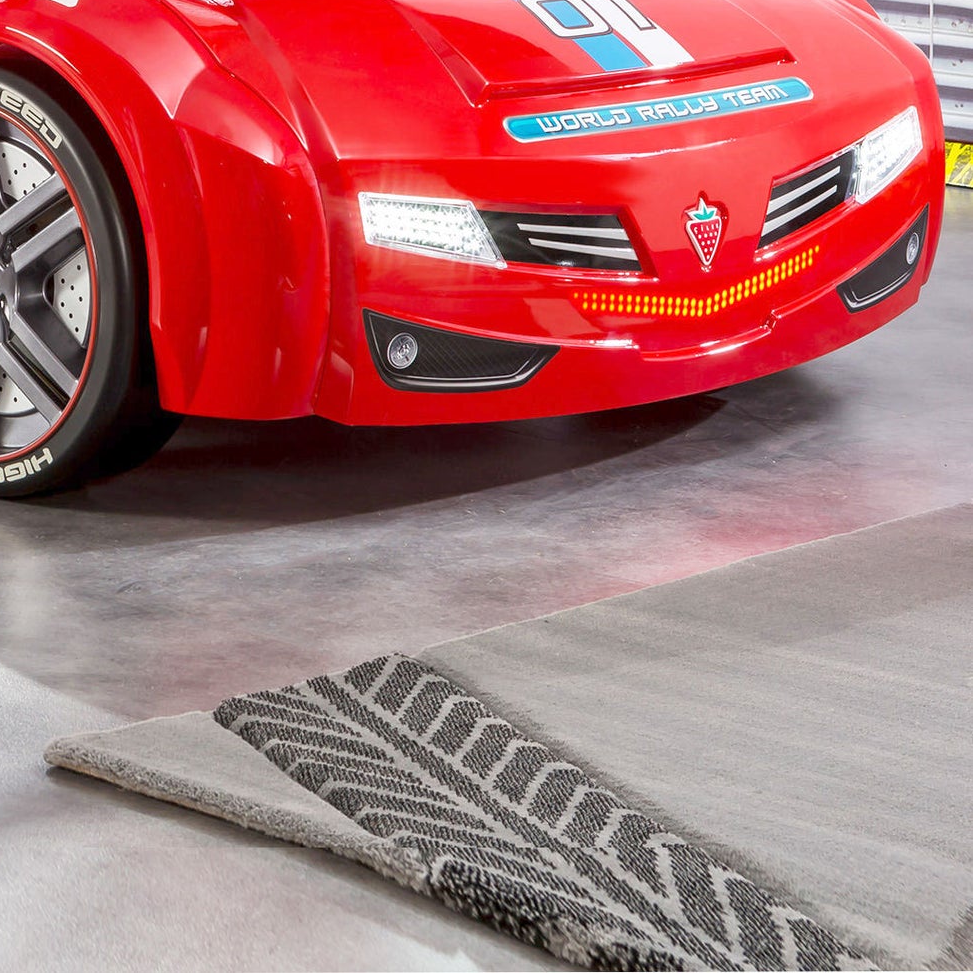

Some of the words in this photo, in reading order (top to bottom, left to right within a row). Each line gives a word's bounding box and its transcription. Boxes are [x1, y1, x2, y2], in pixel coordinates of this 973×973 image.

[535, 108, 632, 134] WORLD
[636, 95, 720, 122] RALLY
[723, 83, 791, 109] TEAM
